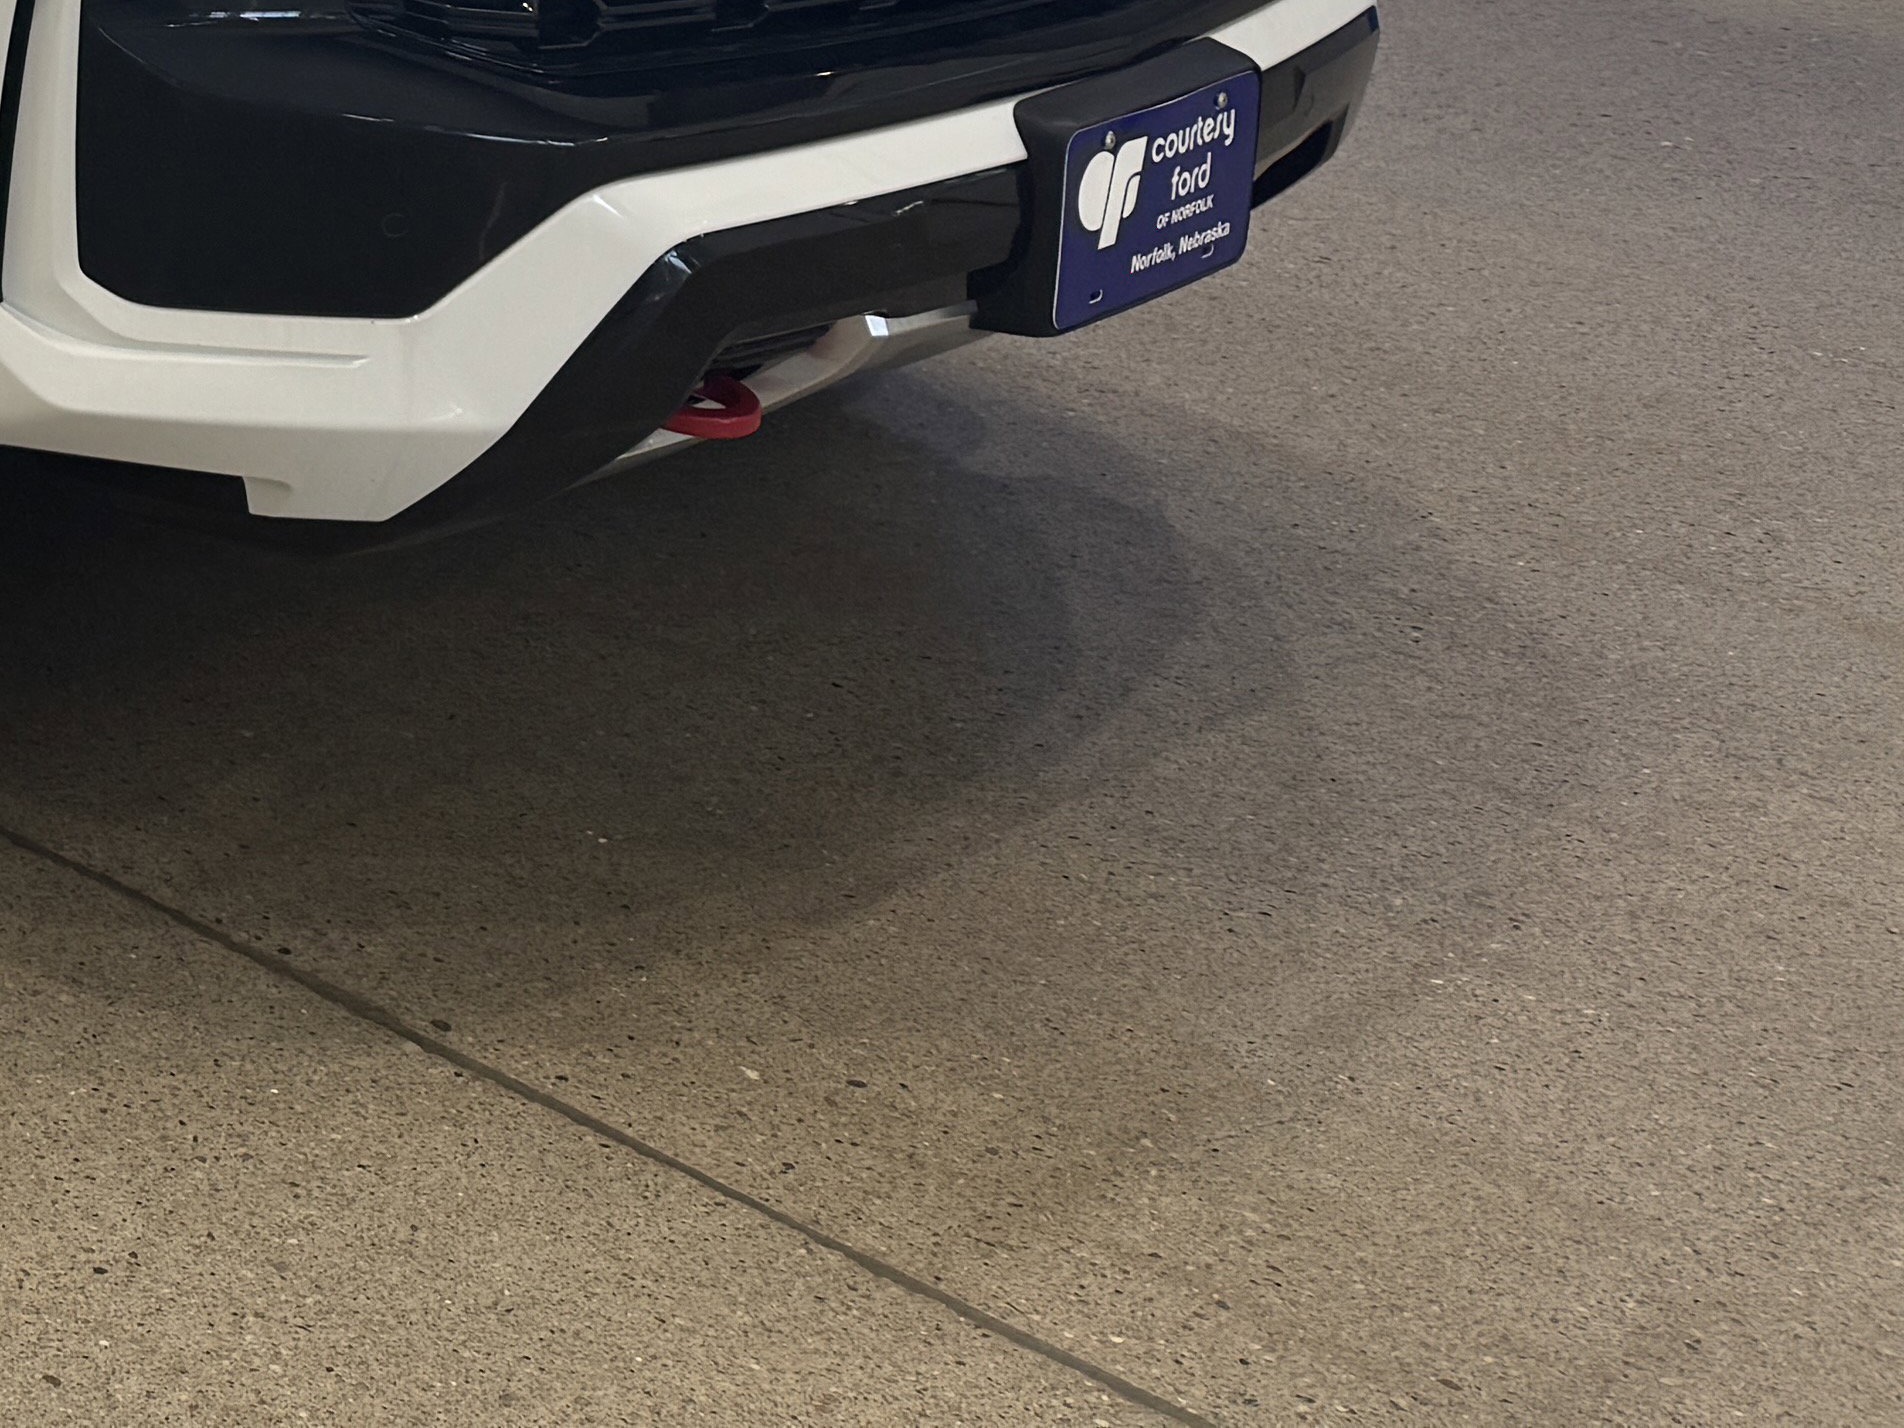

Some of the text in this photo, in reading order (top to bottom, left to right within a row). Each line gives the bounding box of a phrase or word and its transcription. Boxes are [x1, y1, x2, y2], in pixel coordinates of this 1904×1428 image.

[1151, 107, 1236, 164] courtesy
[1171, 151, 1212, 201] ford
[1156, 194, 1215, 230] OF NORFOLK
[1130, 220, 1230, 274] Norfolk, Nebraska
